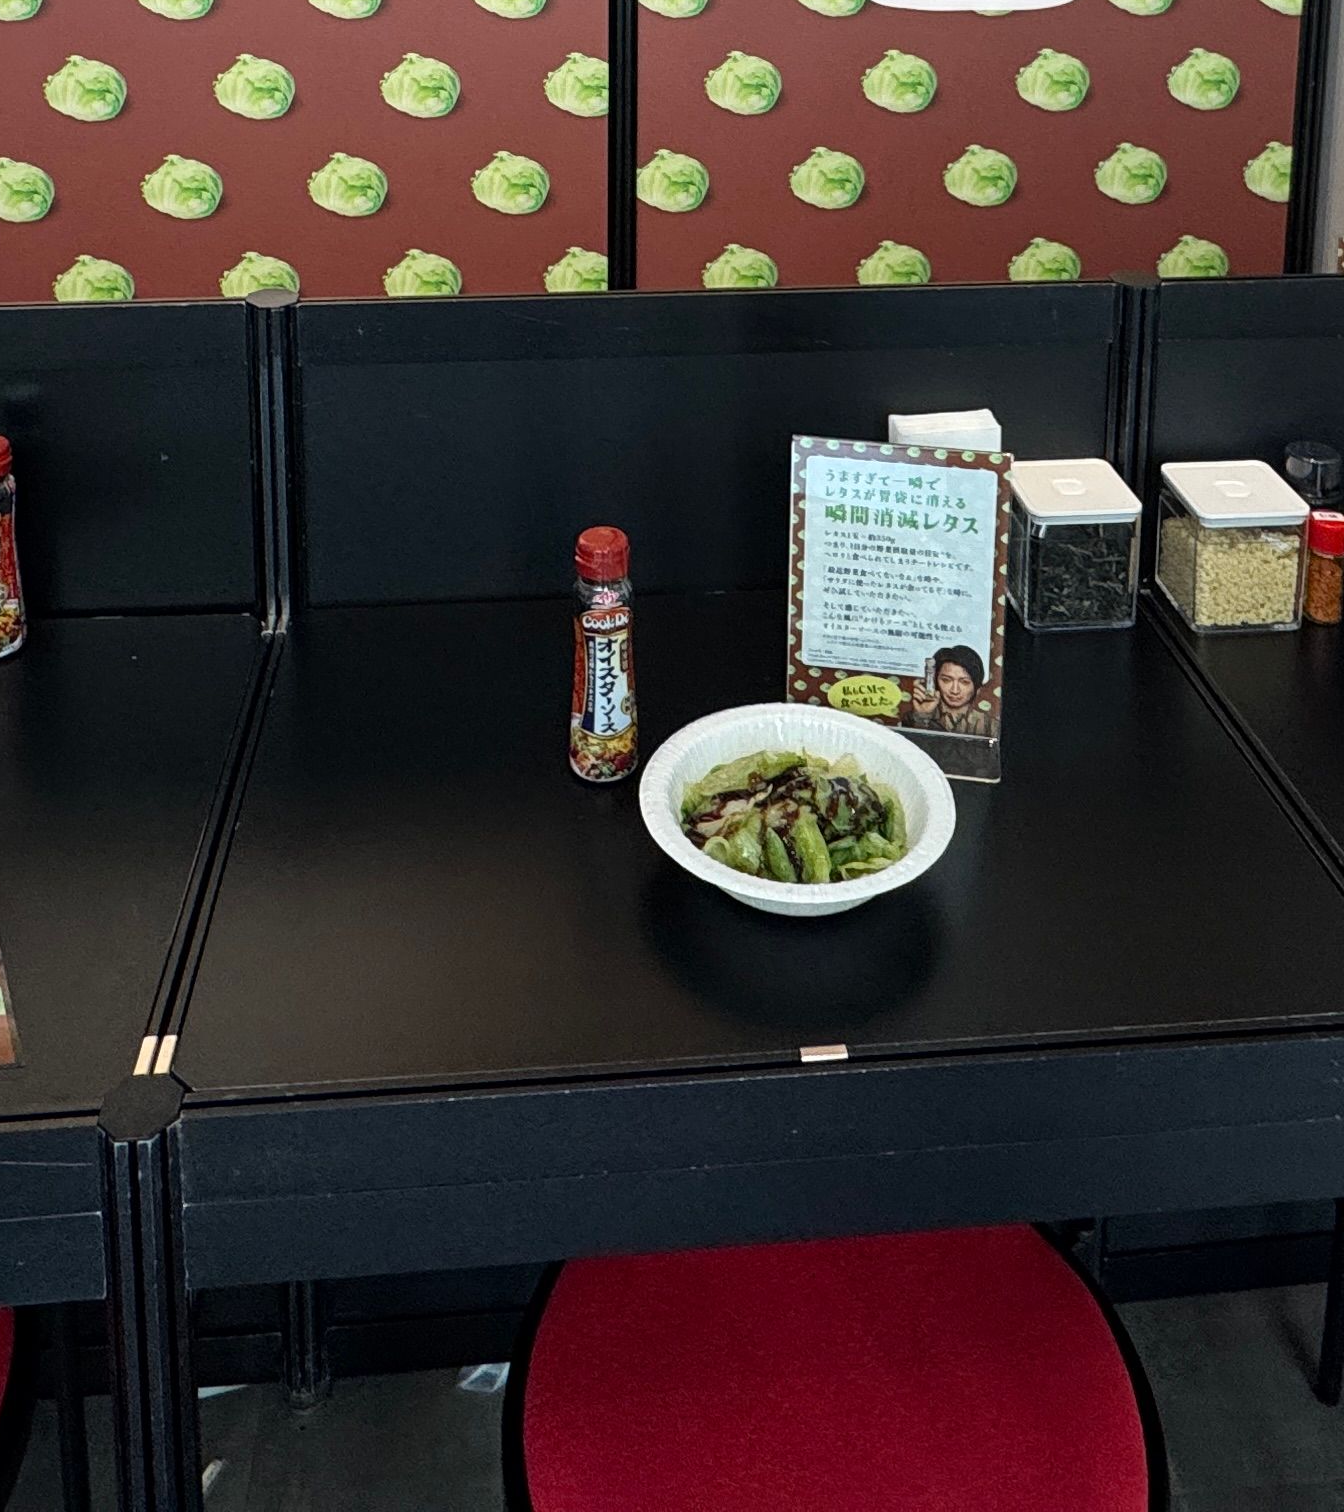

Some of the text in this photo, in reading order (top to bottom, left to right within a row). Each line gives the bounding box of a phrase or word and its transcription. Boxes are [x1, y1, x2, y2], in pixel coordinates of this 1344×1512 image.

[825, 468, 941, 491] うますぎて一瞬で
[824, 503, 980, 535] 瞬間消滅レタス
[597, 637, 619, 734] オイスターソース
